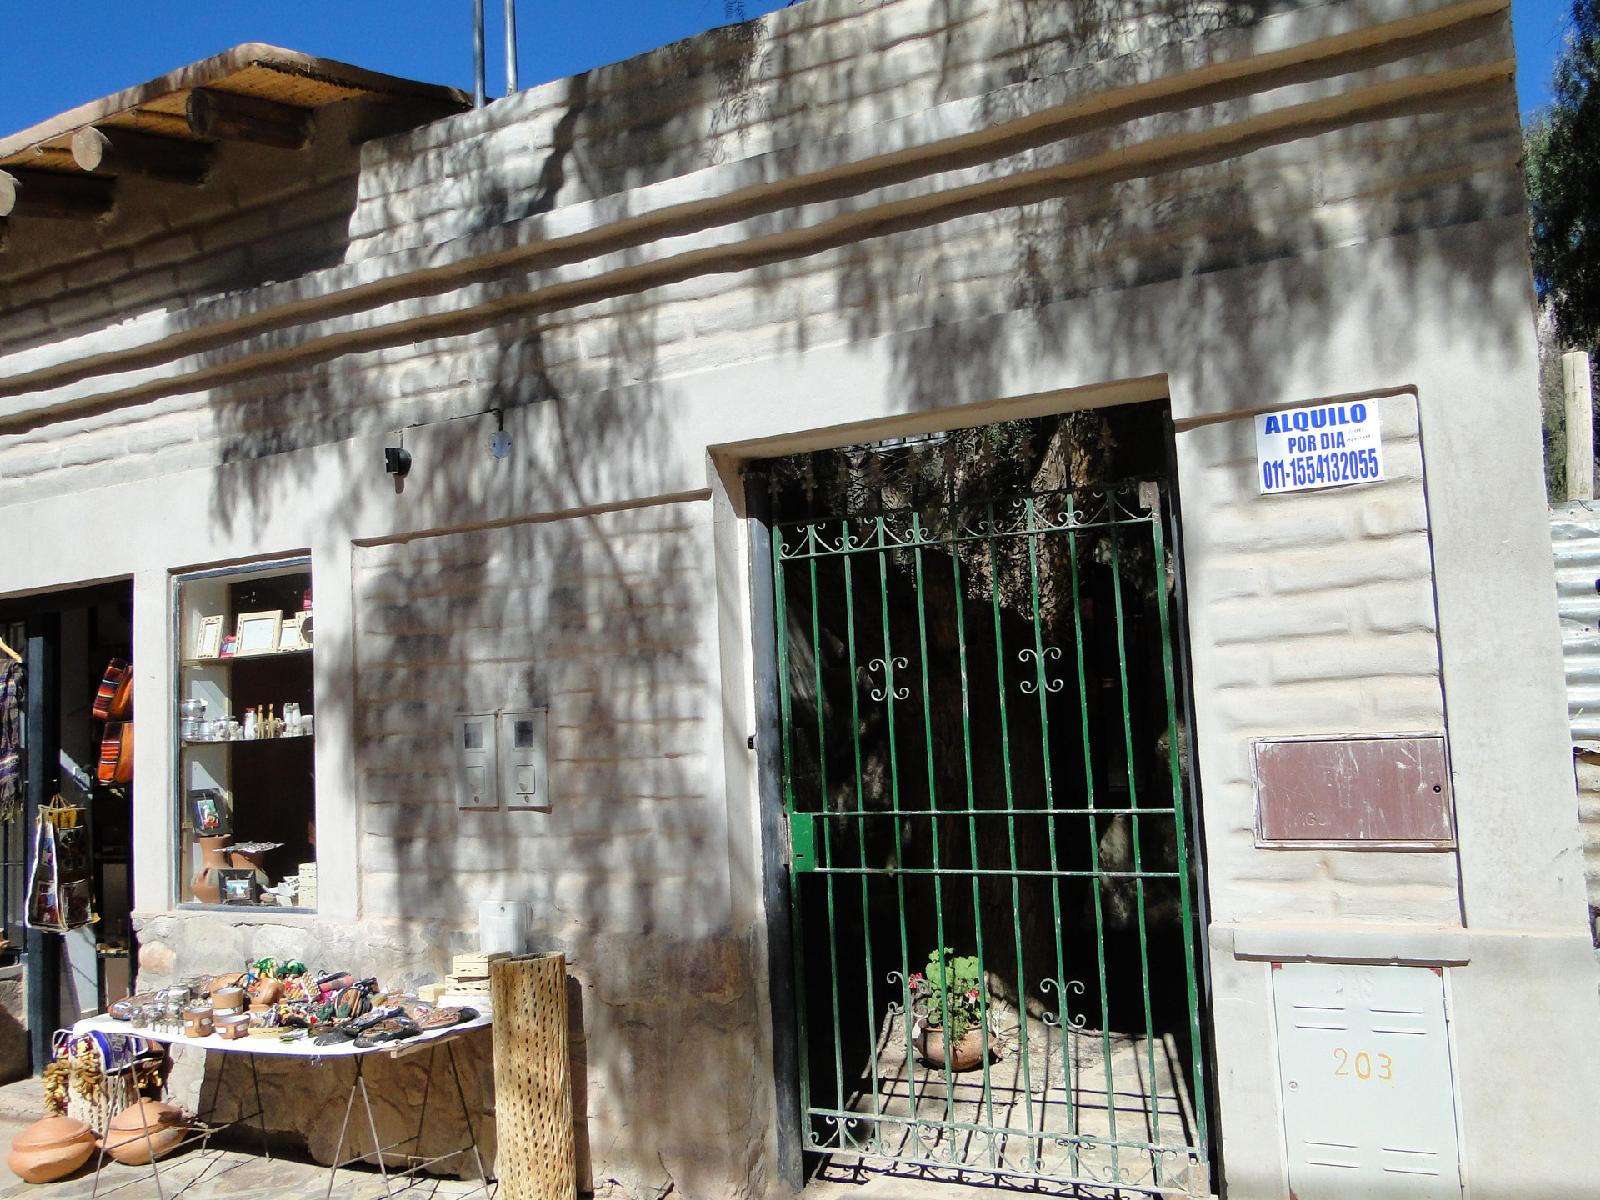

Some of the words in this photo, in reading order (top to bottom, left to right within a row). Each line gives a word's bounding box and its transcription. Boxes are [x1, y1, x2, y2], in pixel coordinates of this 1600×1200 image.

[1264, 403, 1367, 435] ALQUILO
[1287, 435, 1318, 454] POR
[1320, 431, 1346, 449] DIA
[1262, 448, 1379, 490] 011-1554132055
[1333, 1047, 1393, 1080] 203
